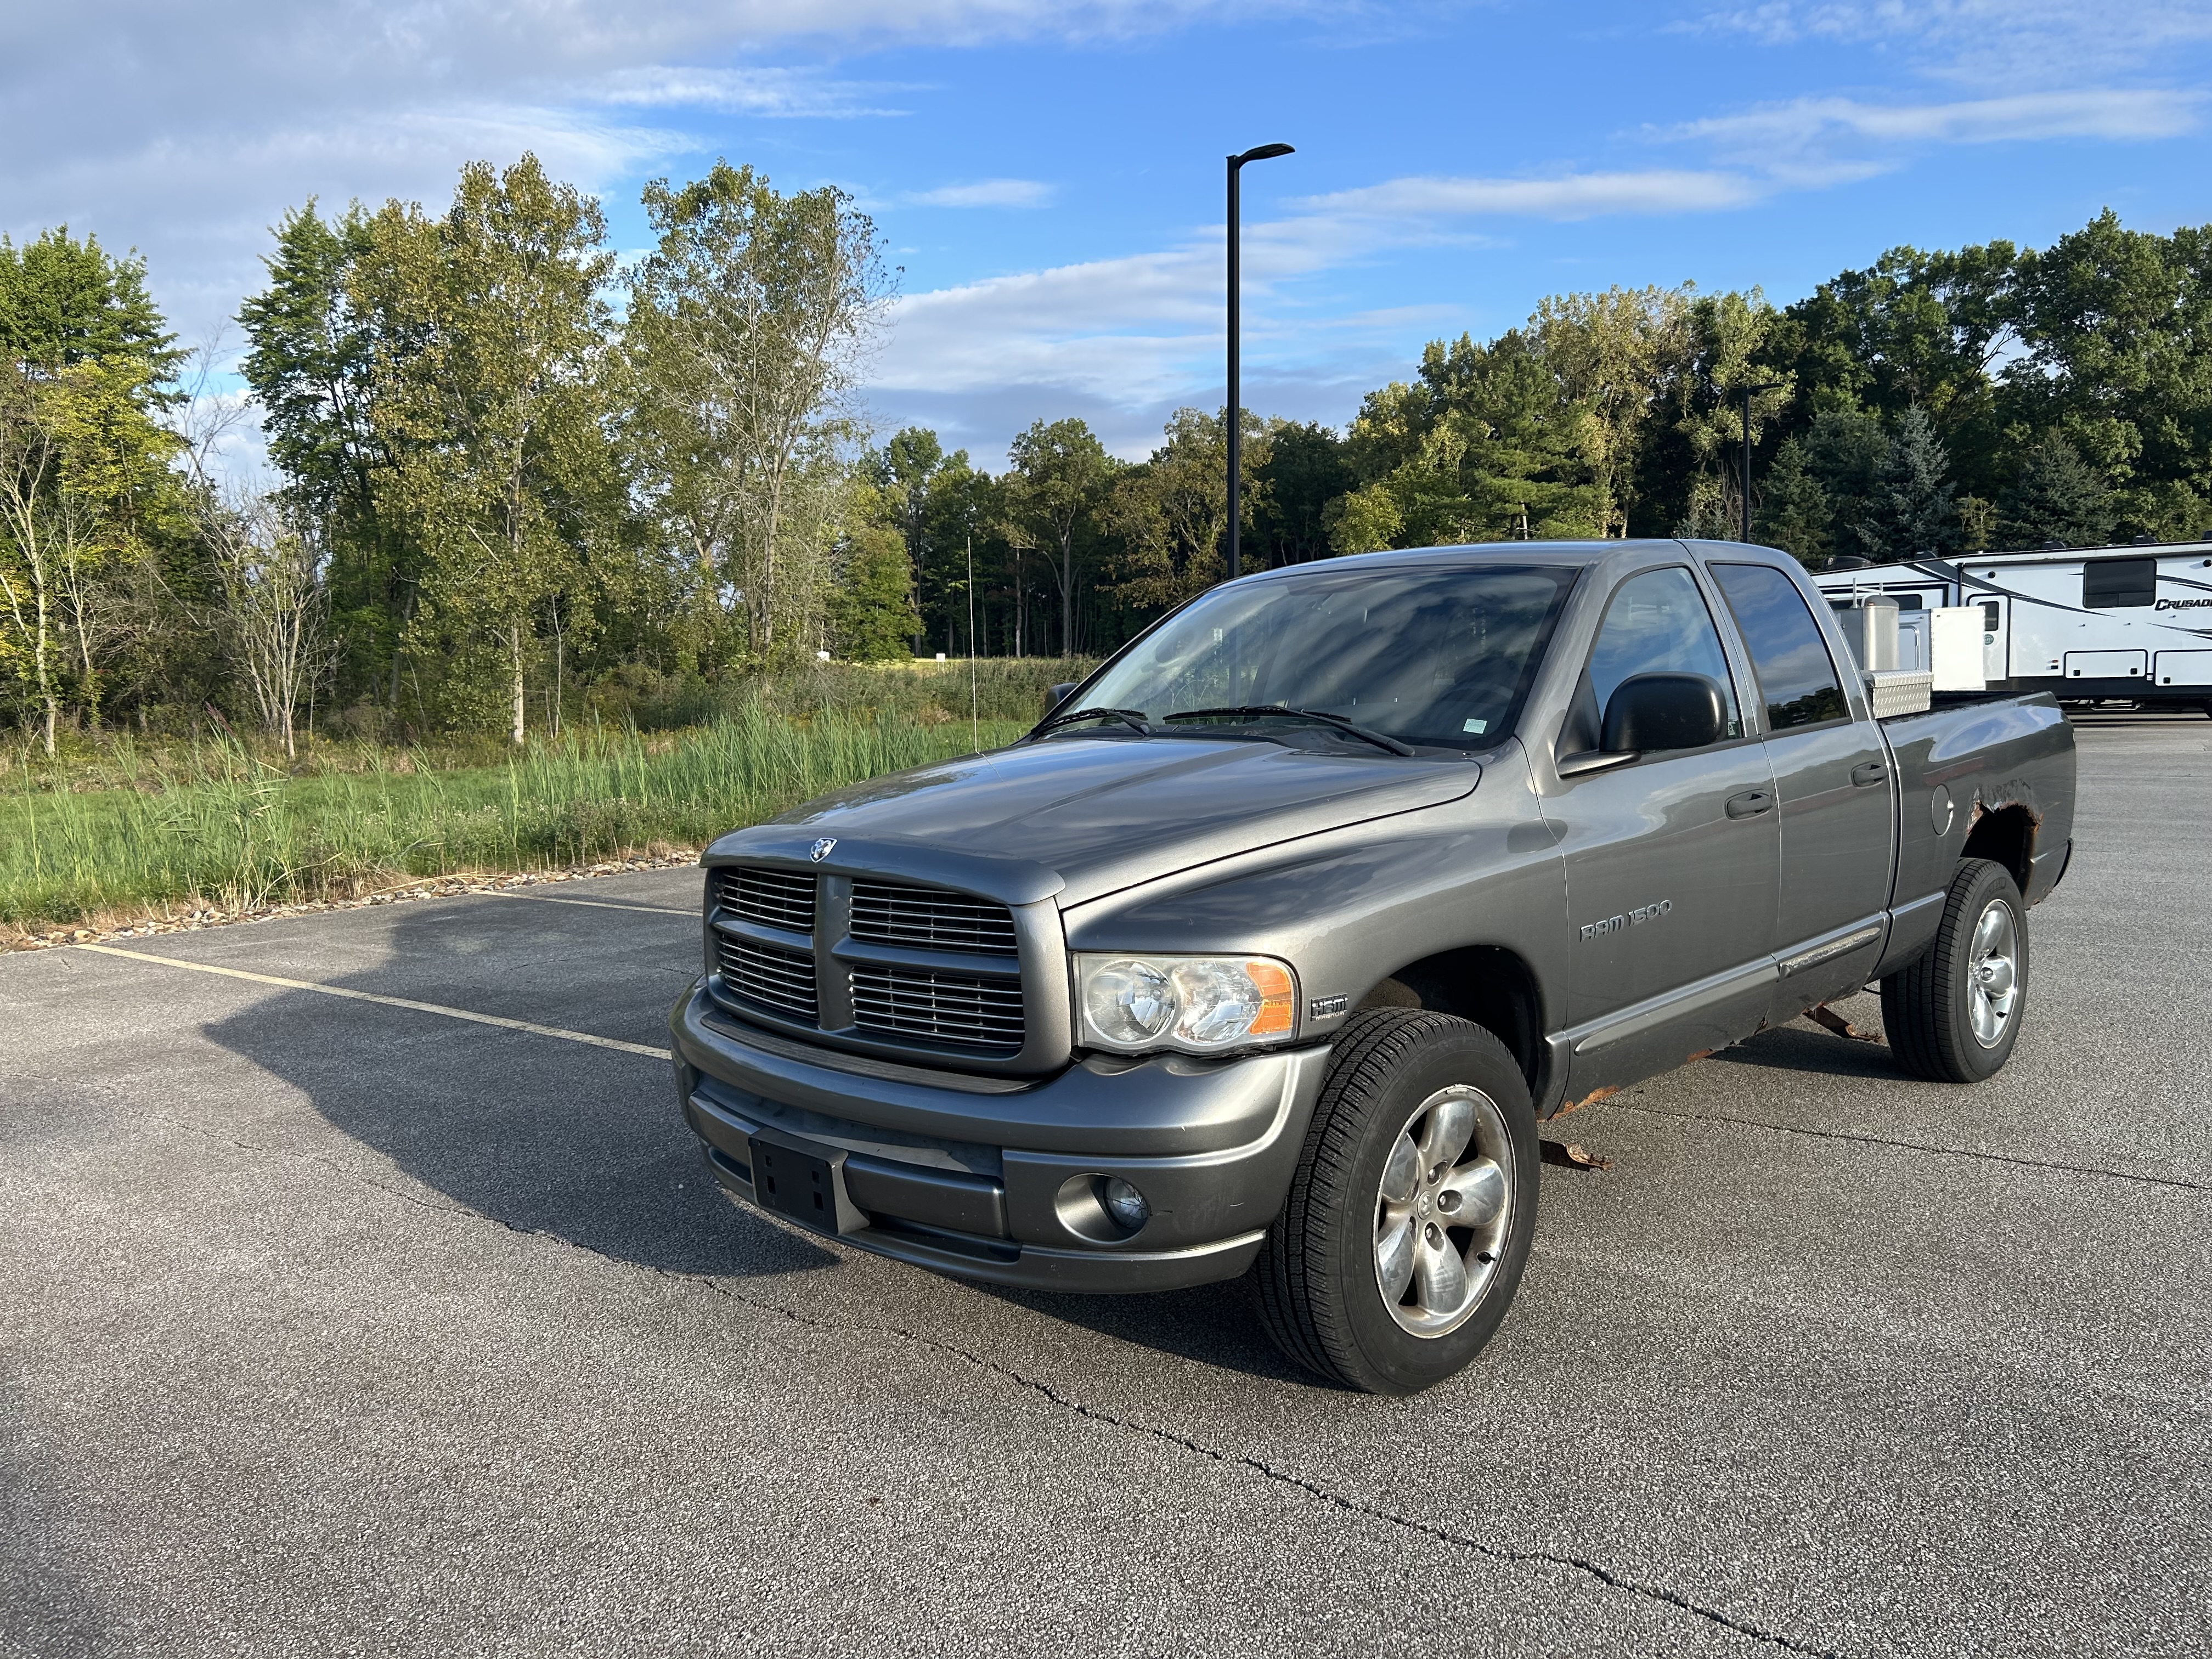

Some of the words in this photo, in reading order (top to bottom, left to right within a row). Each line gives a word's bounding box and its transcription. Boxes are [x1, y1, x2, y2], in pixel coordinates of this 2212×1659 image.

[2154, 599, 2212, 611] CRUSAD
[1579, 915, 1624, 943] RAM
[1627, 900, 1673, 927] 1500
[1312, 997, 1348, 1017] HEMI
